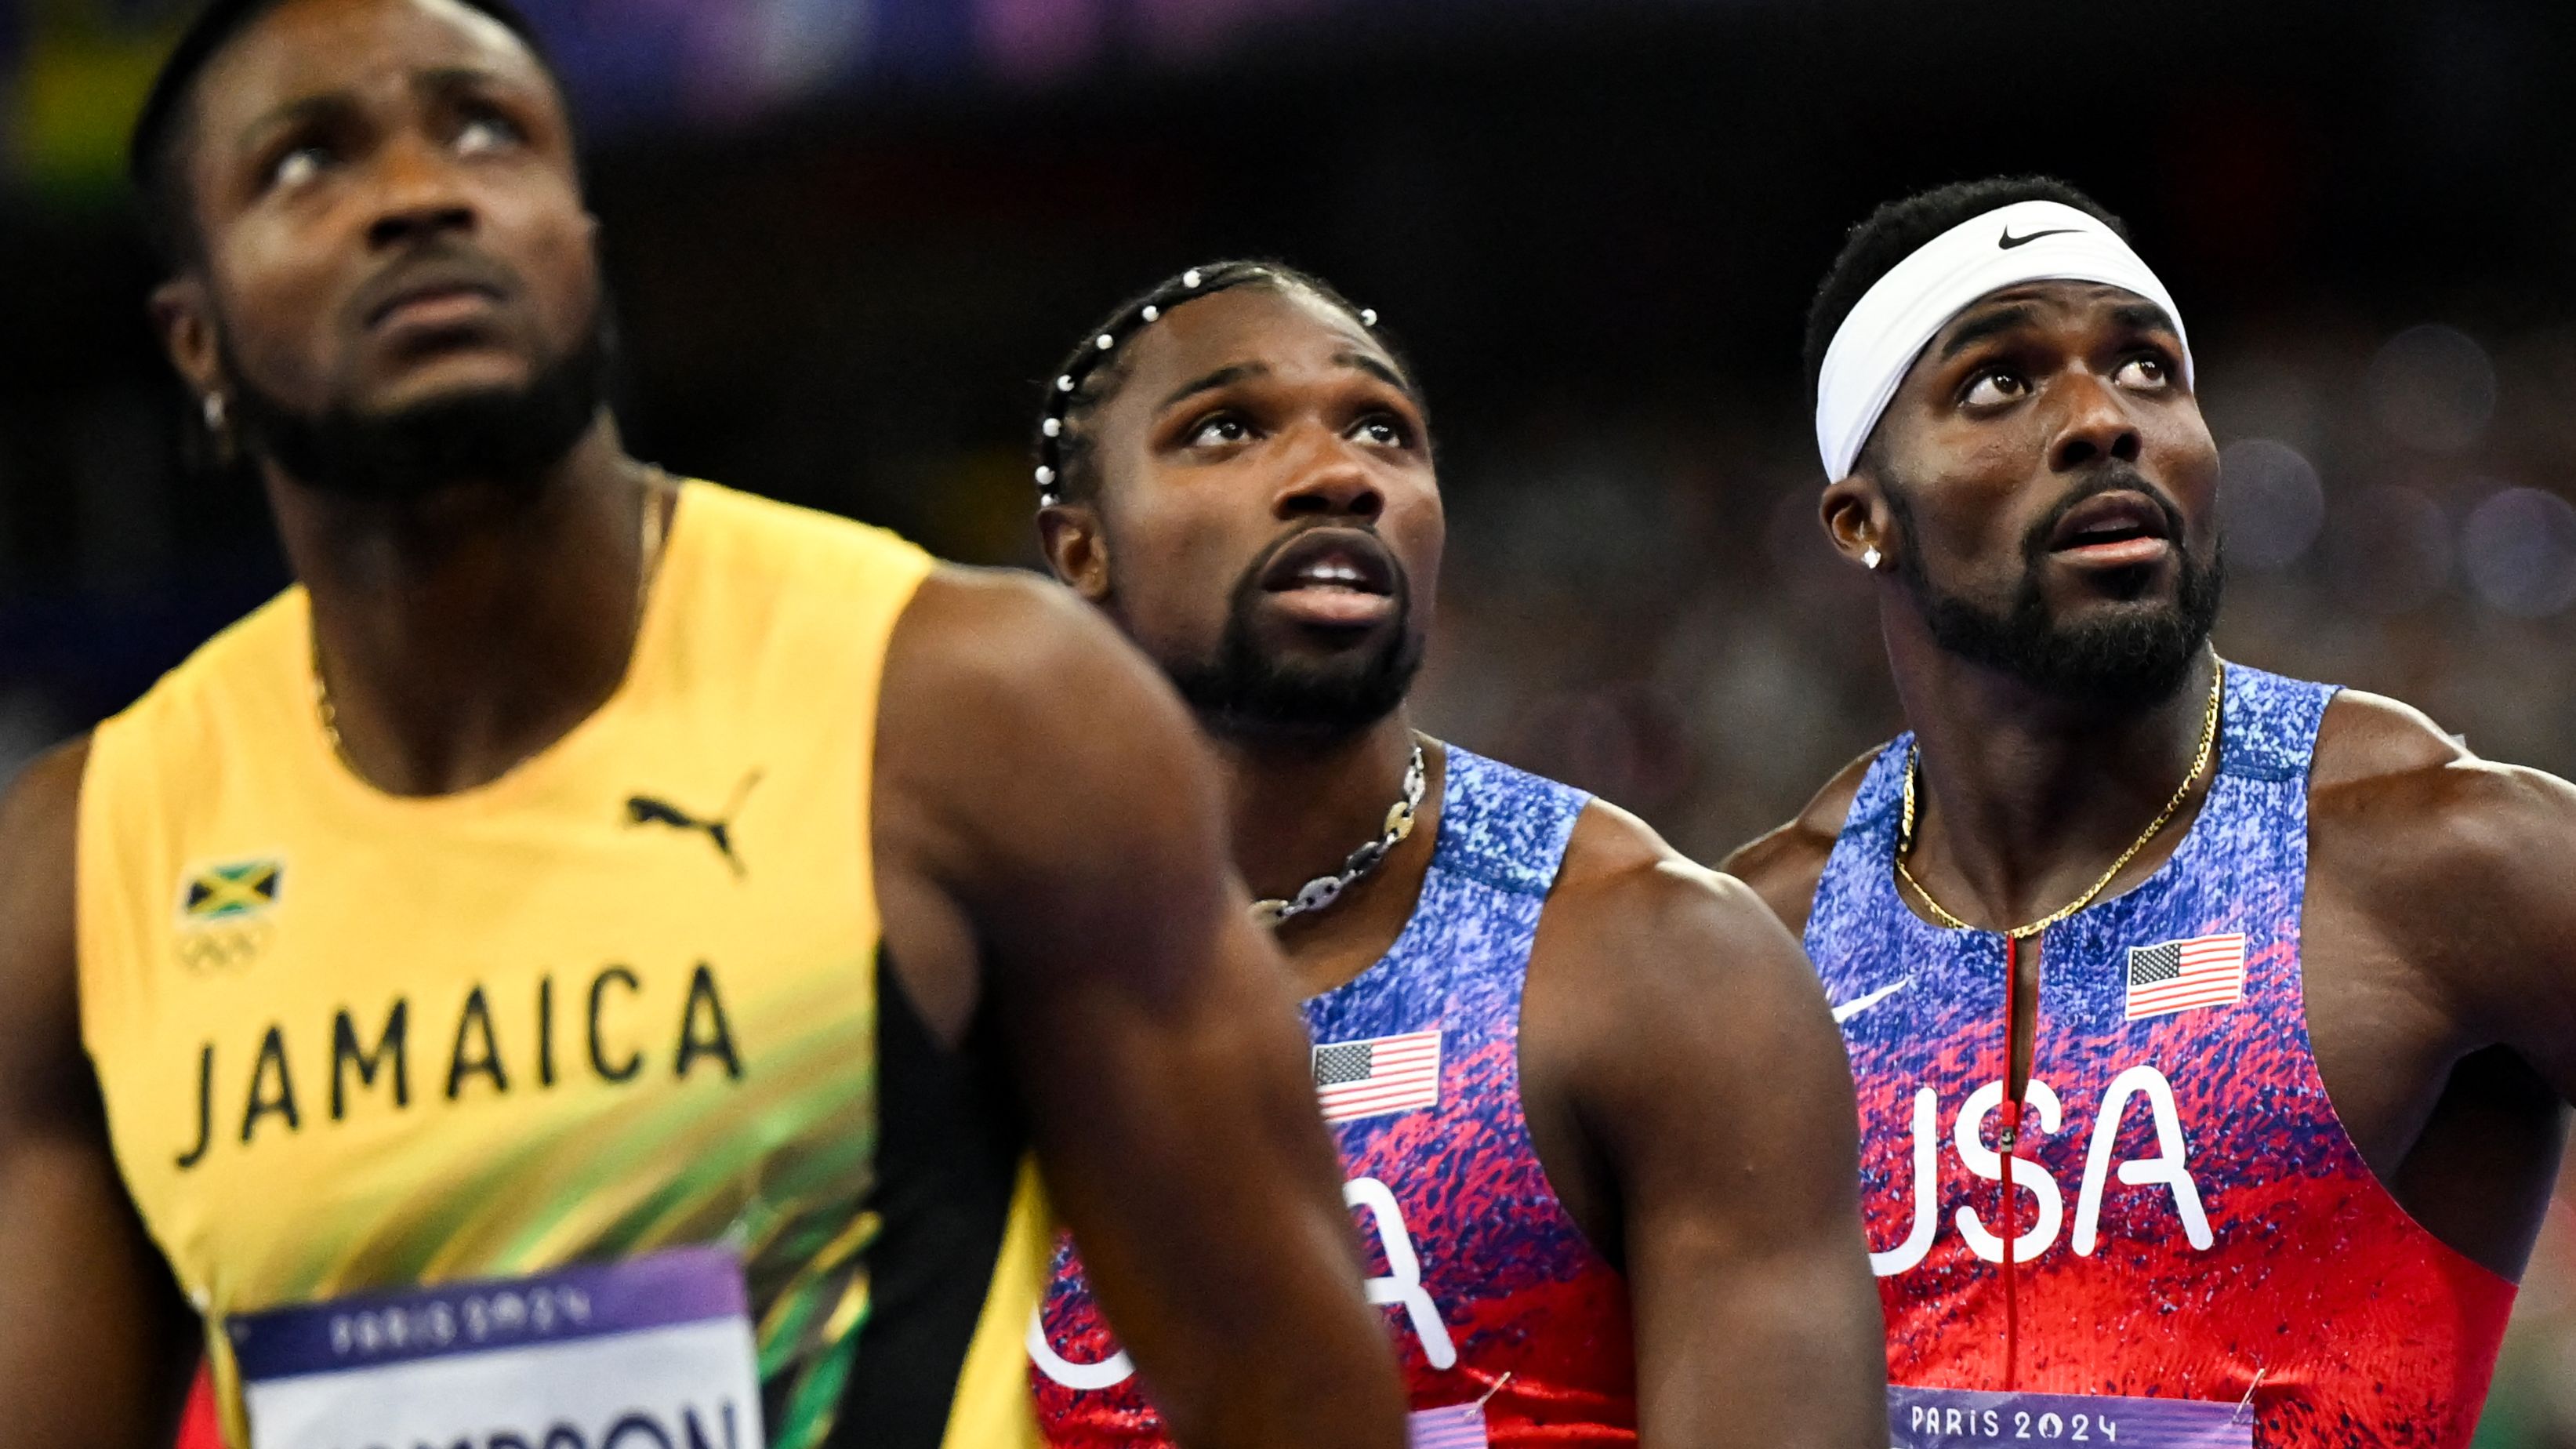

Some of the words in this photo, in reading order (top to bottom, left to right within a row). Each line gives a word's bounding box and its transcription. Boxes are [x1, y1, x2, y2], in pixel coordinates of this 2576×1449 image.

[176, 964, 744, 1170] JAMAICA
[1912, 1406, 1999, 1437] PARIS
[2015, 1411, 2116, 1443] 2024
